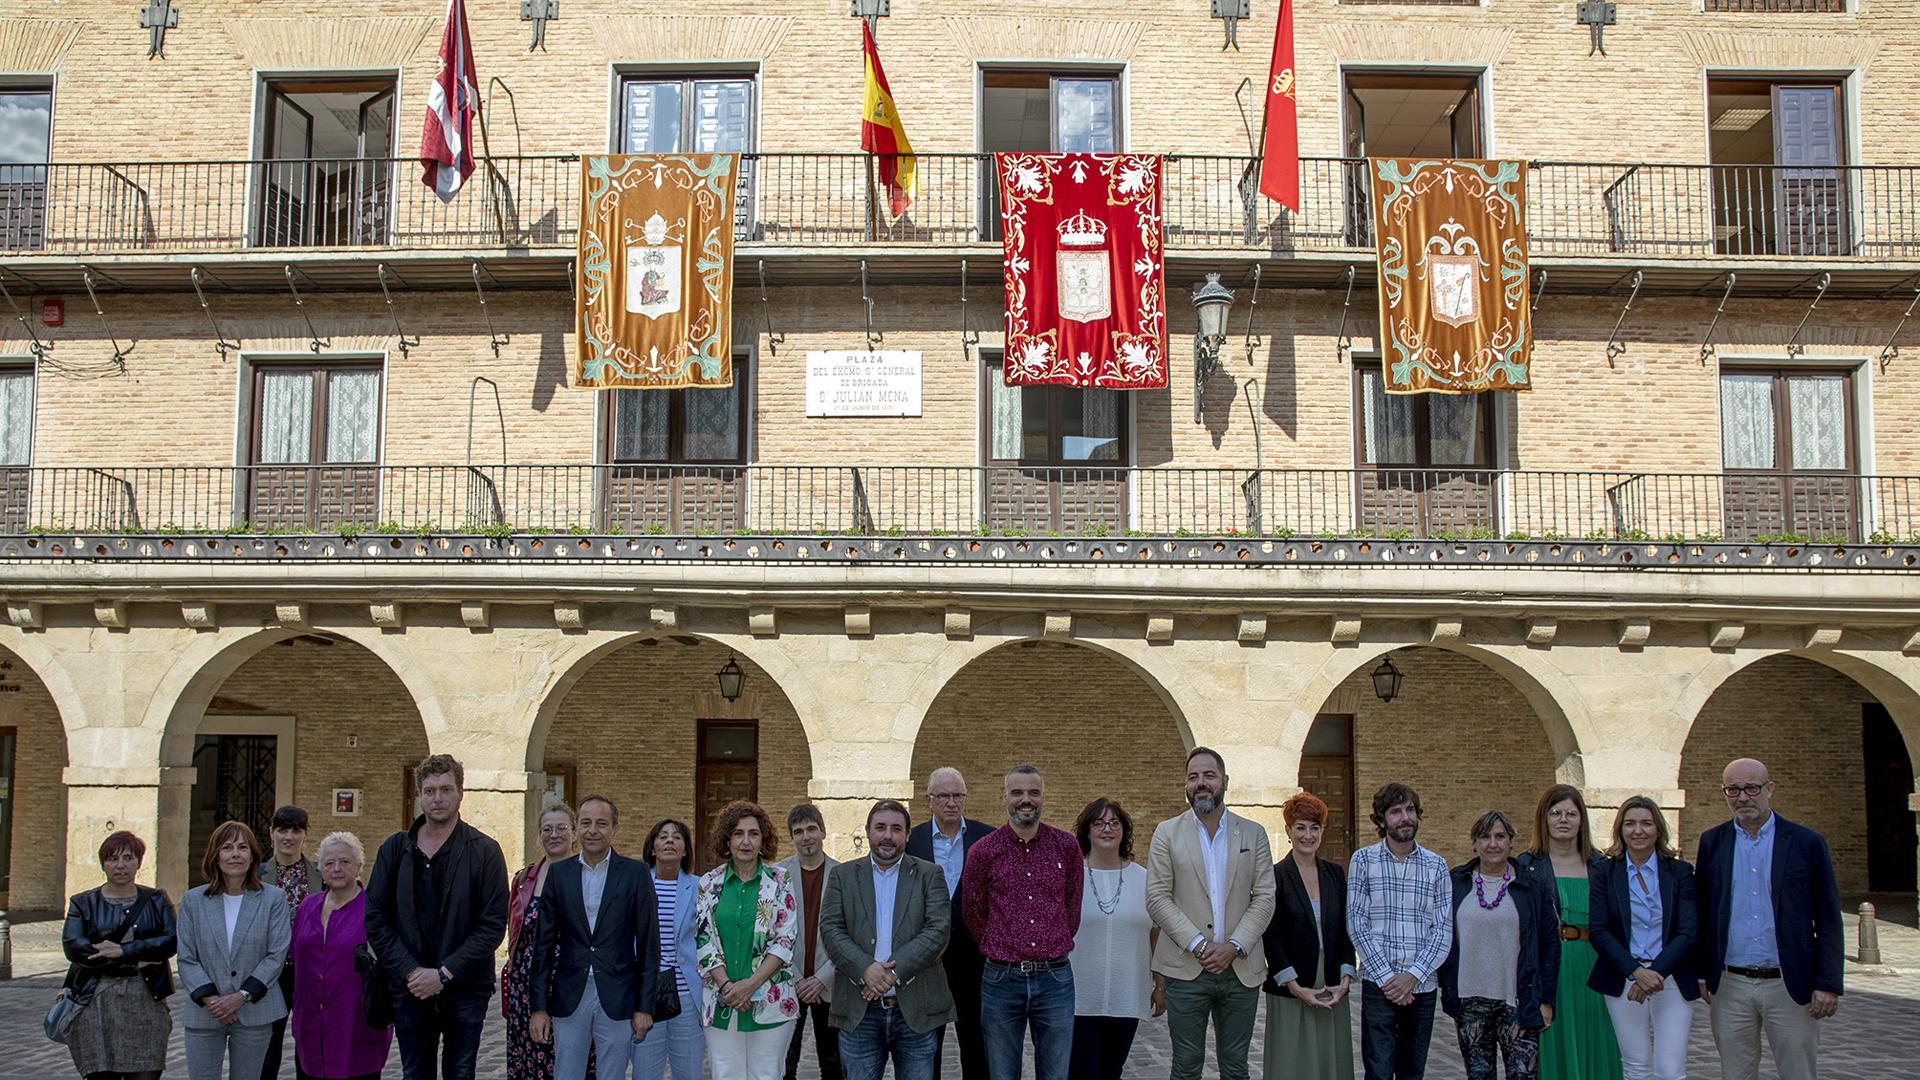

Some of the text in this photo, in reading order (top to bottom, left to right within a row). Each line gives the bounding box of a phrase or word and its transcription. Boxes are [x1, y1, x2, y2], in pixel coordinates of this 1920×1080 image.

[846, 355, 883, 364] PLAZA
[813, 367, 829, 376] DEL
[876, 366, 915, 376] GENERAL
[840, 379, 850, 387] DE
[832, 390, 873, 403] JULIAN
